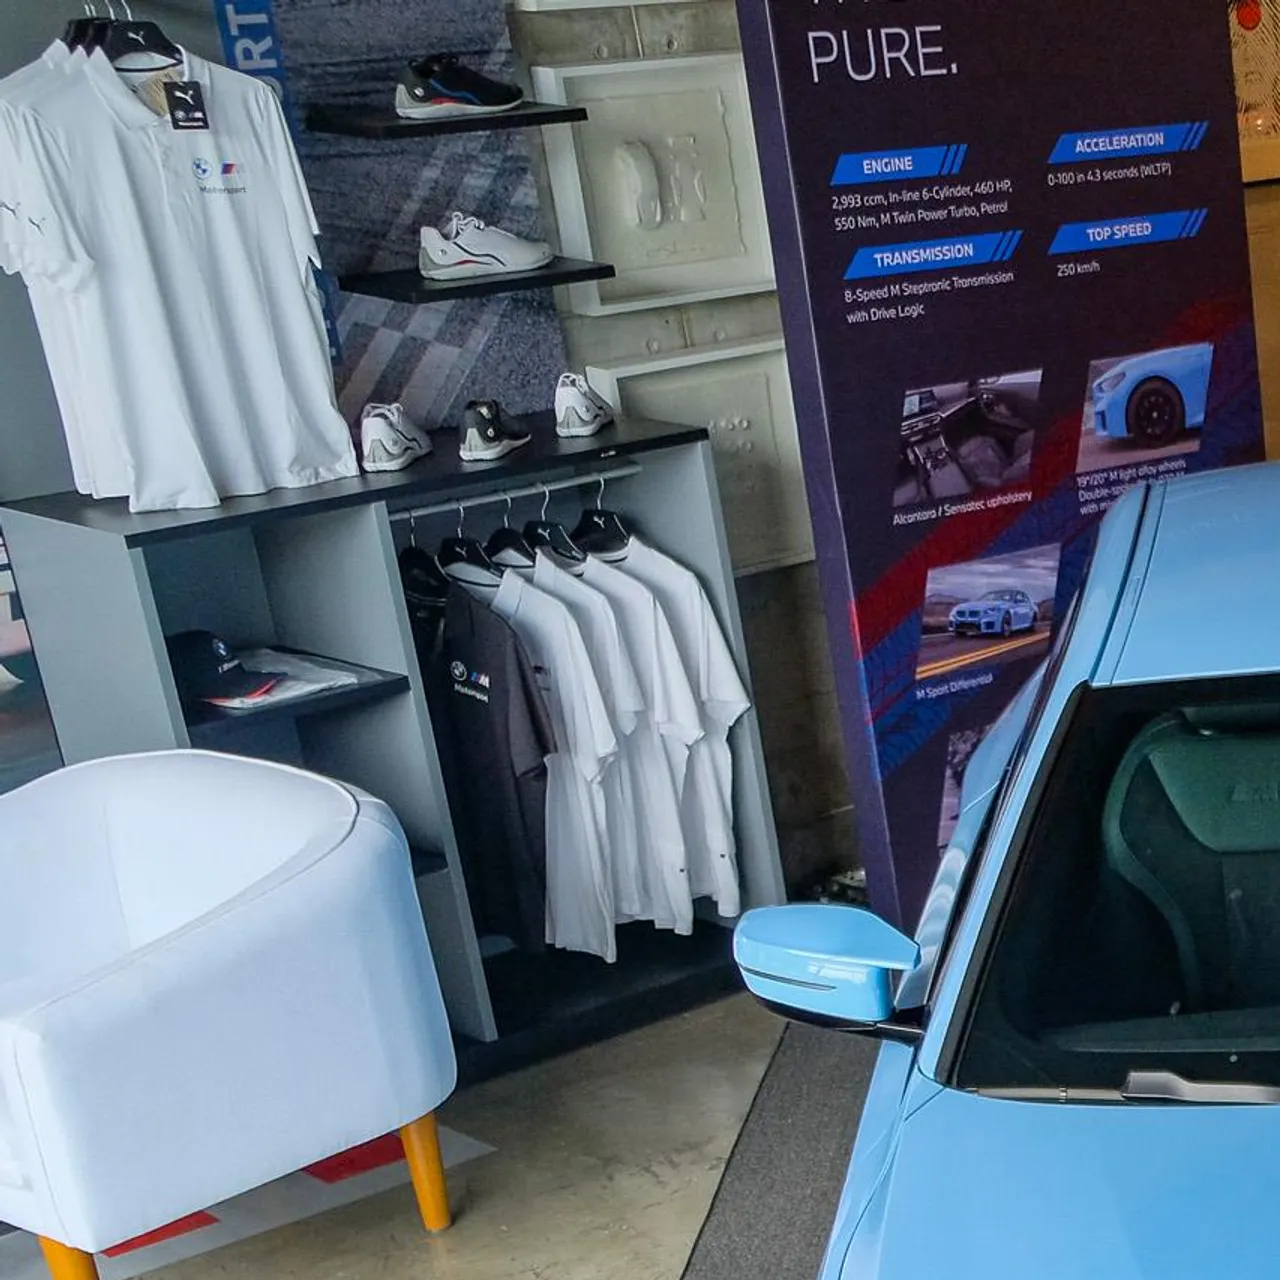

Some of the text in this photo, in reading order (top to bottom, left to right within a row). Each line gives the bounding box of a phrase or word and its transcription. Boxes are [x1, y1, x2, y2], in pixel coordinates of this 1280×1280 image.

[807, 25, 958, 84] PURE.
[1075, 132, 1165, 154] ACCELERATION
[862, 155, 914, 174] ENGINE
[1047, 171, 1076, 187] 0-100
[1076, 172, 1086, 184] in
[1102, 165, 1140, 181] seconds
[1140, 161, 1172, 180] (WLTP)
[832, 193, 862, 211] 2,993
[863, 191, 889, 207] ccm,
[974, 180, 995, 194] 460
[834, 200, 1009, 232] 550 Nm, M Twin Power Turbo, Petrol
[1086, 222, 1153, 243] TOP SPEED
[873, 243, 974, 269] TRANSMISSION
[1056, 260, 1101, 278] 250 km/h
[844, 270, 1015, 304] 8-Speed M Steptronic Transmission
[846, 303, 926, 324] with Drive Logic
[1109, 470, 1119, 482] M
[1118, 467, 1138, 482] light
[1158, 459, 1187, 472] wheels
[892, 509, 937, 526] Alcantara
[943, 499, 987, 517] Sensatec
[986, 491, 1033, 509] upholstery
[915, 688, 926, 701] M
[926, 682, 950, 699] Sport
